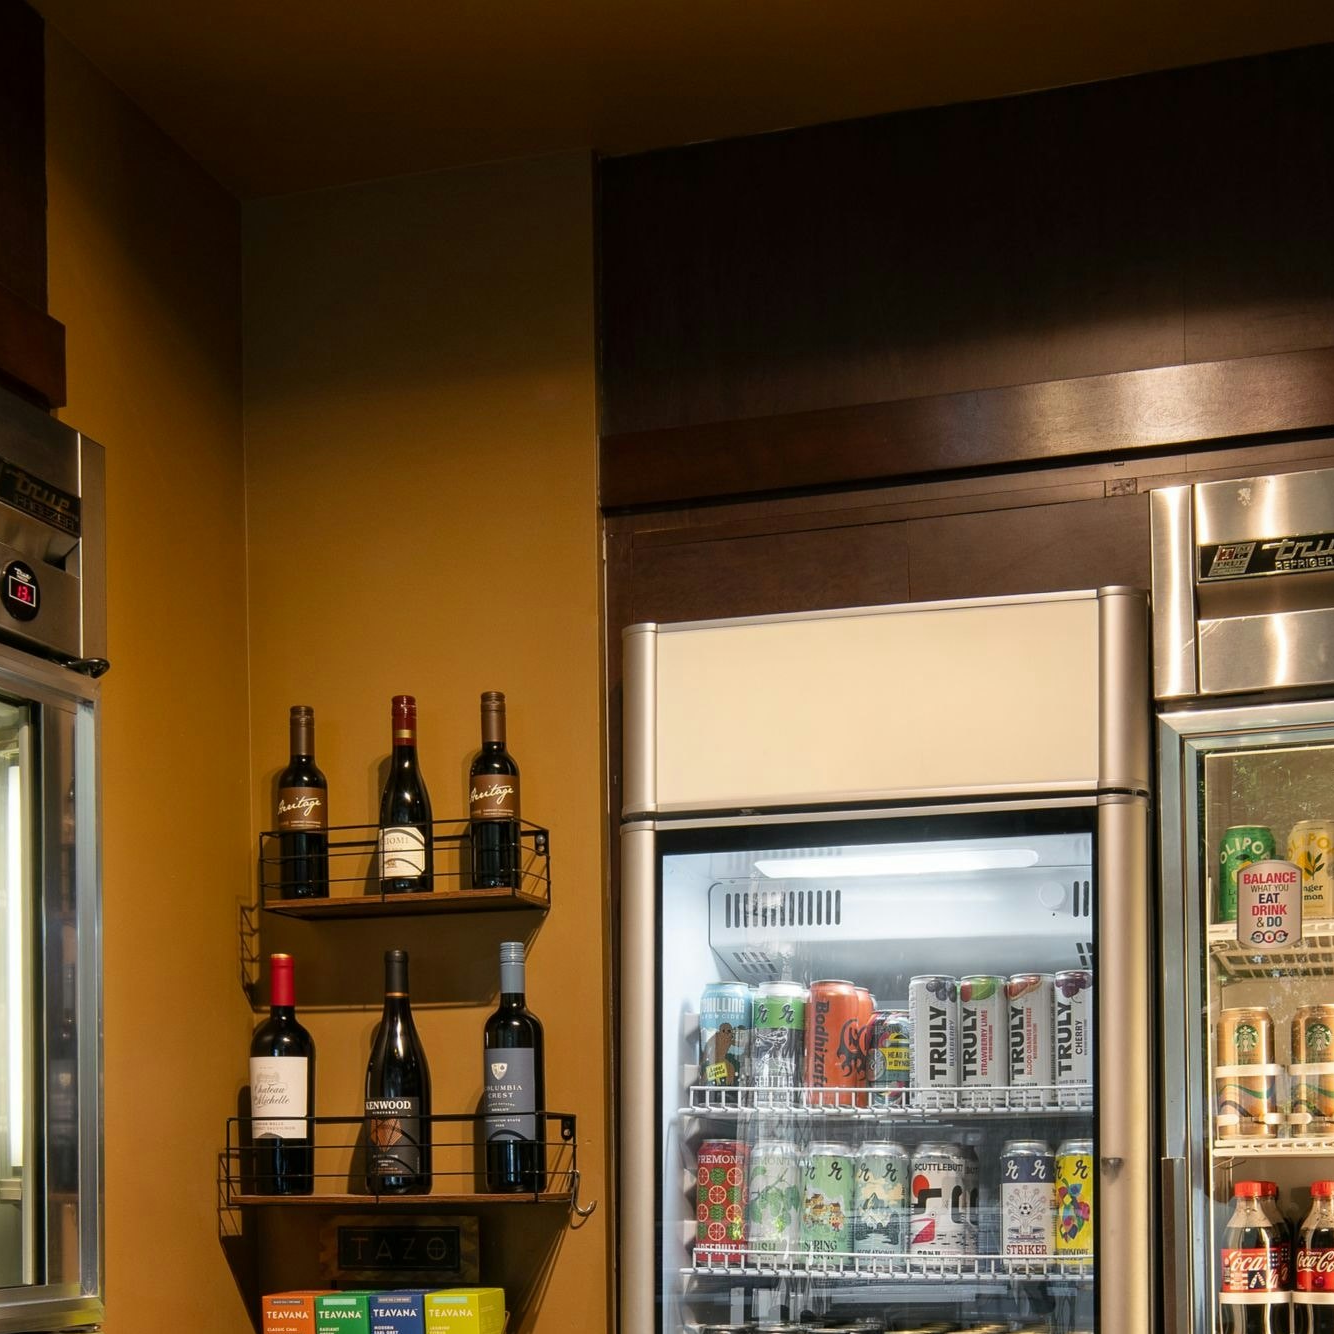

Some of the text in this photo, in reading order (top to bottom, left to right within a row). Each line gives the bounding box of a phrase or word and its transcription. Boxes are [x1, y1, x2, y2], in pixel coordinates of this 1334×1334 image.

[1243, 871, 1297, 884] BALANCE
[1250, 884, 1289, 893] WHAT YOU
[1303, 884, 1324, 893] nger
[1251, 904, 1287, 916] DRINK
[1256, 916, 1283, 927] & DO
[929, 1005, 947, 1081] TRULY
[962, 1007, 977, 1082] TRULY
[980, 1009, 988, 1076] STRAWBERRY LIME
[1011, 1005, 1025, 1081] TRULY
[1057, 1001, 1072, 1077] TRULY
[365, 1100, 412, 1110] KENWOOD
[697, 1154, 744, 1164] FREMONT
[350, 1236, 447, 1261] TAZO
[804, 1239, 838, 1251] SPRING
[1006, 1244, 1048, 1255] STRIKER
[266, 1311, 309, 1319] TEAVANA
[319, 1310, 362, 1319] TEAVANA
[373, 1309, 417, 1317] TEAVANA
[429, 1309, 474, 1317] TEAVANA
